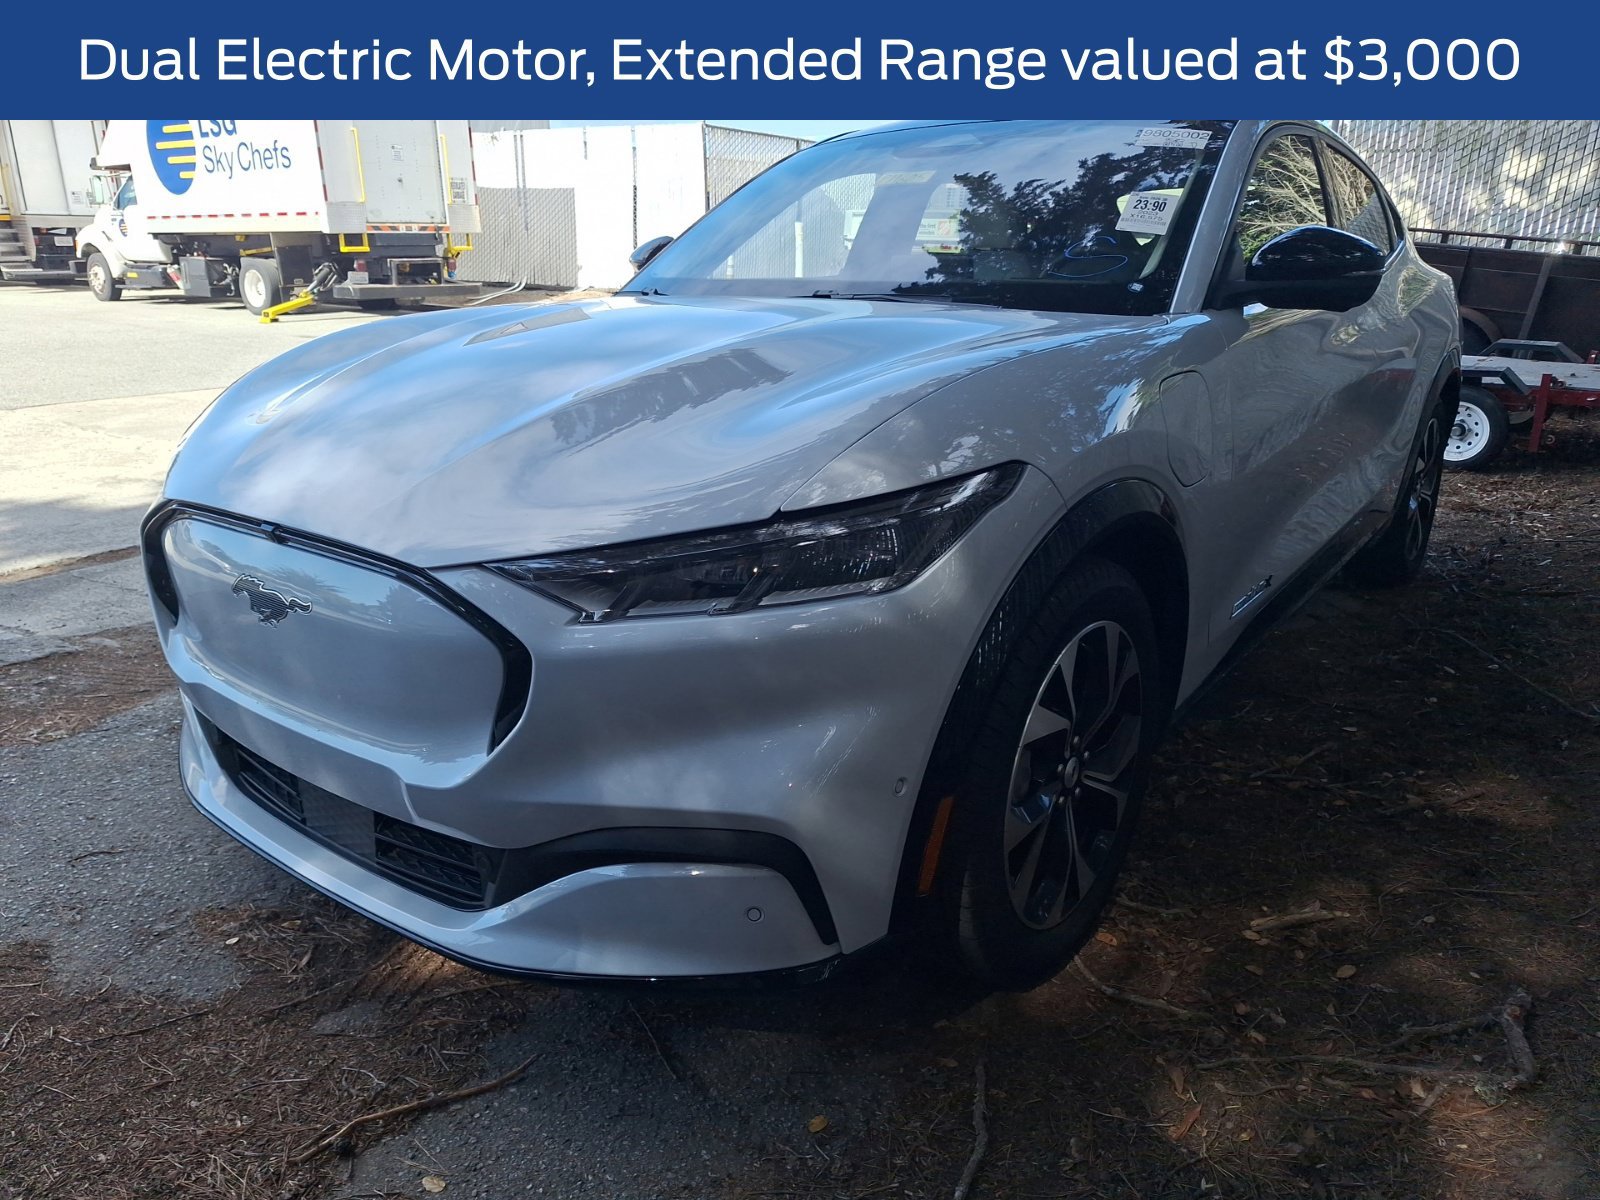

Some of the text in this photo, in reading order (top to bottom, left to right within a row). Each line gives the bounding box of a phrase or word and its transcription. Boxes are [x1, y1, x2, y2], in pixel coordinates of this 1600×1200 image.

[202, 140, 292, 179] Sky Chefs
[1133, 199, 1167, 212] 23:90
